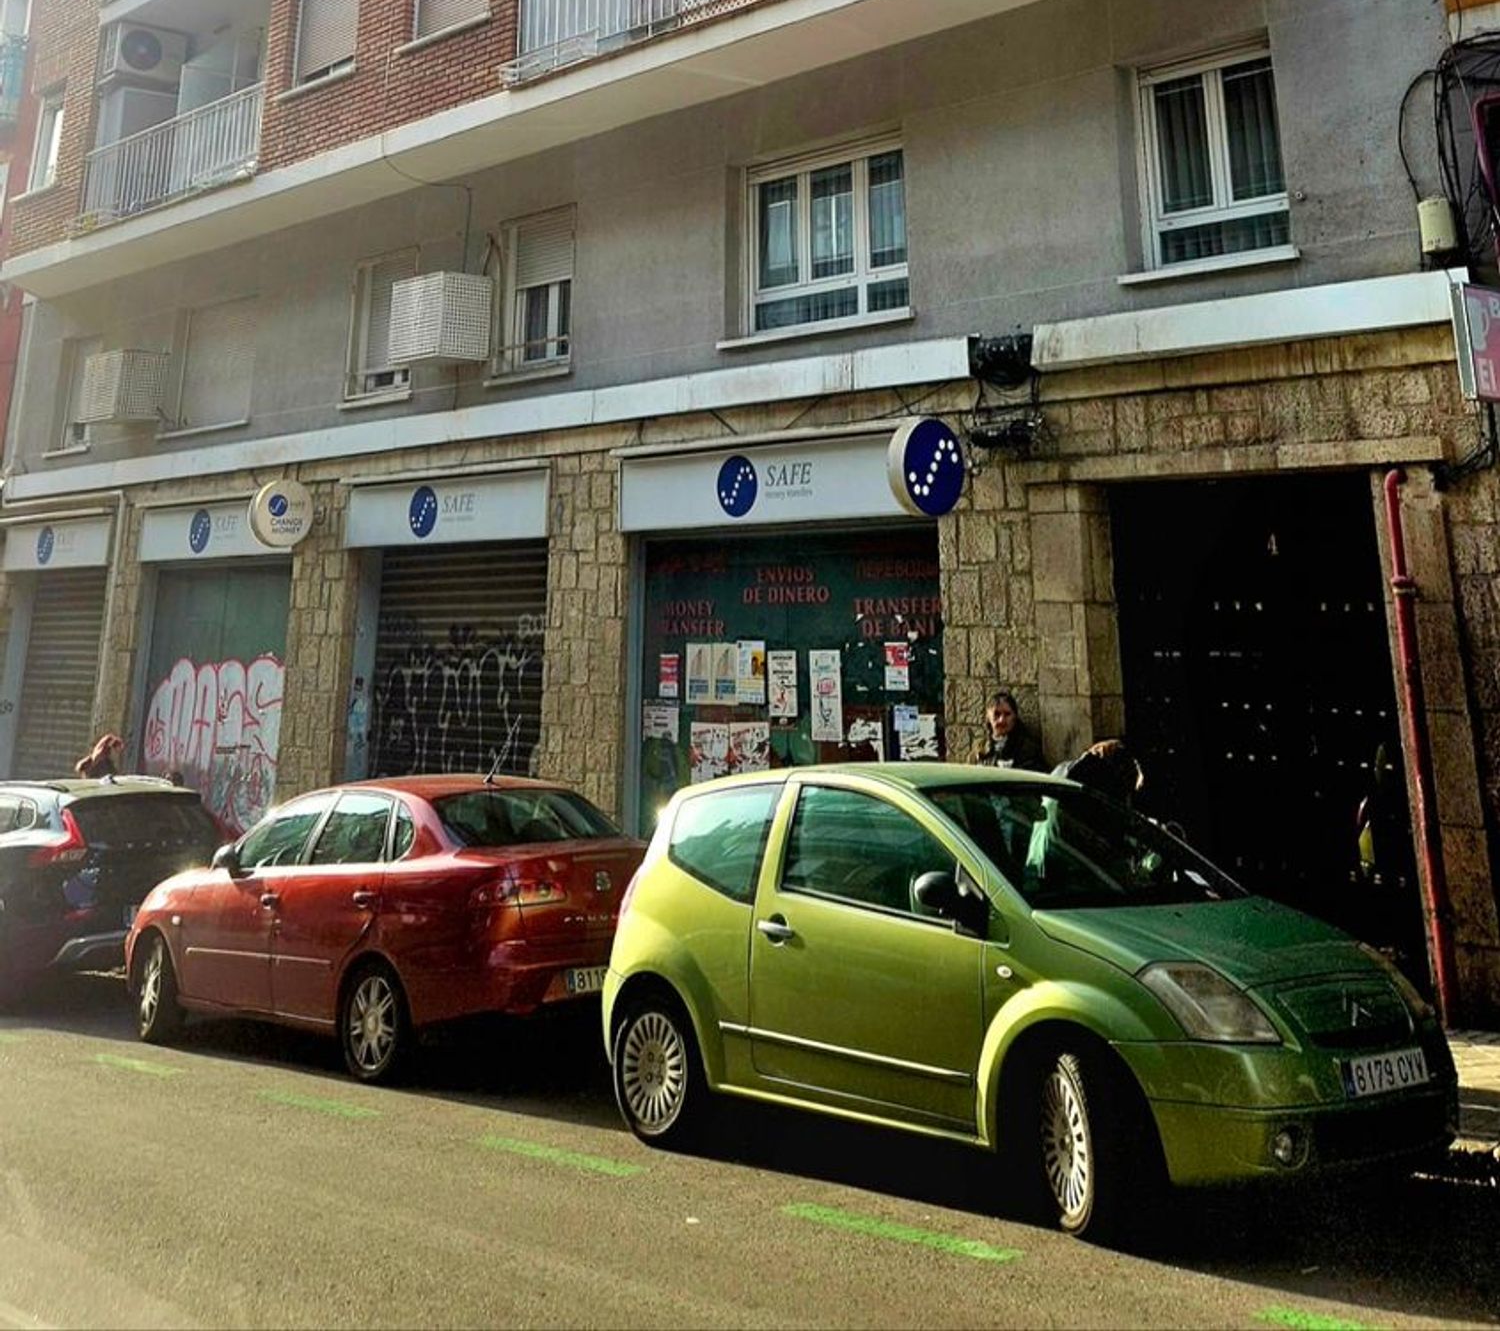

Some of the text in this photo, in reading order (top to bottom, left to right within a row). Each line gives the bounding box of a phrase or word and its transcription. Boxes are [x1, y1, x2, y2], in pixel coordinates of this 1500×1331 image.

[765, 462, 812, 487] SAFE
[442, 493, 475, 513] SAFE
[1267, 533, 1279, 556] 4
[756, 566, 814, 583] ENVIOS
[743, 586, 829, 604] DE DINERO
[853, 597, 940, 615] TRANSFER
[862, 619, 883, 636] DE
[1356, 1059, 1394, 1091] 8179
